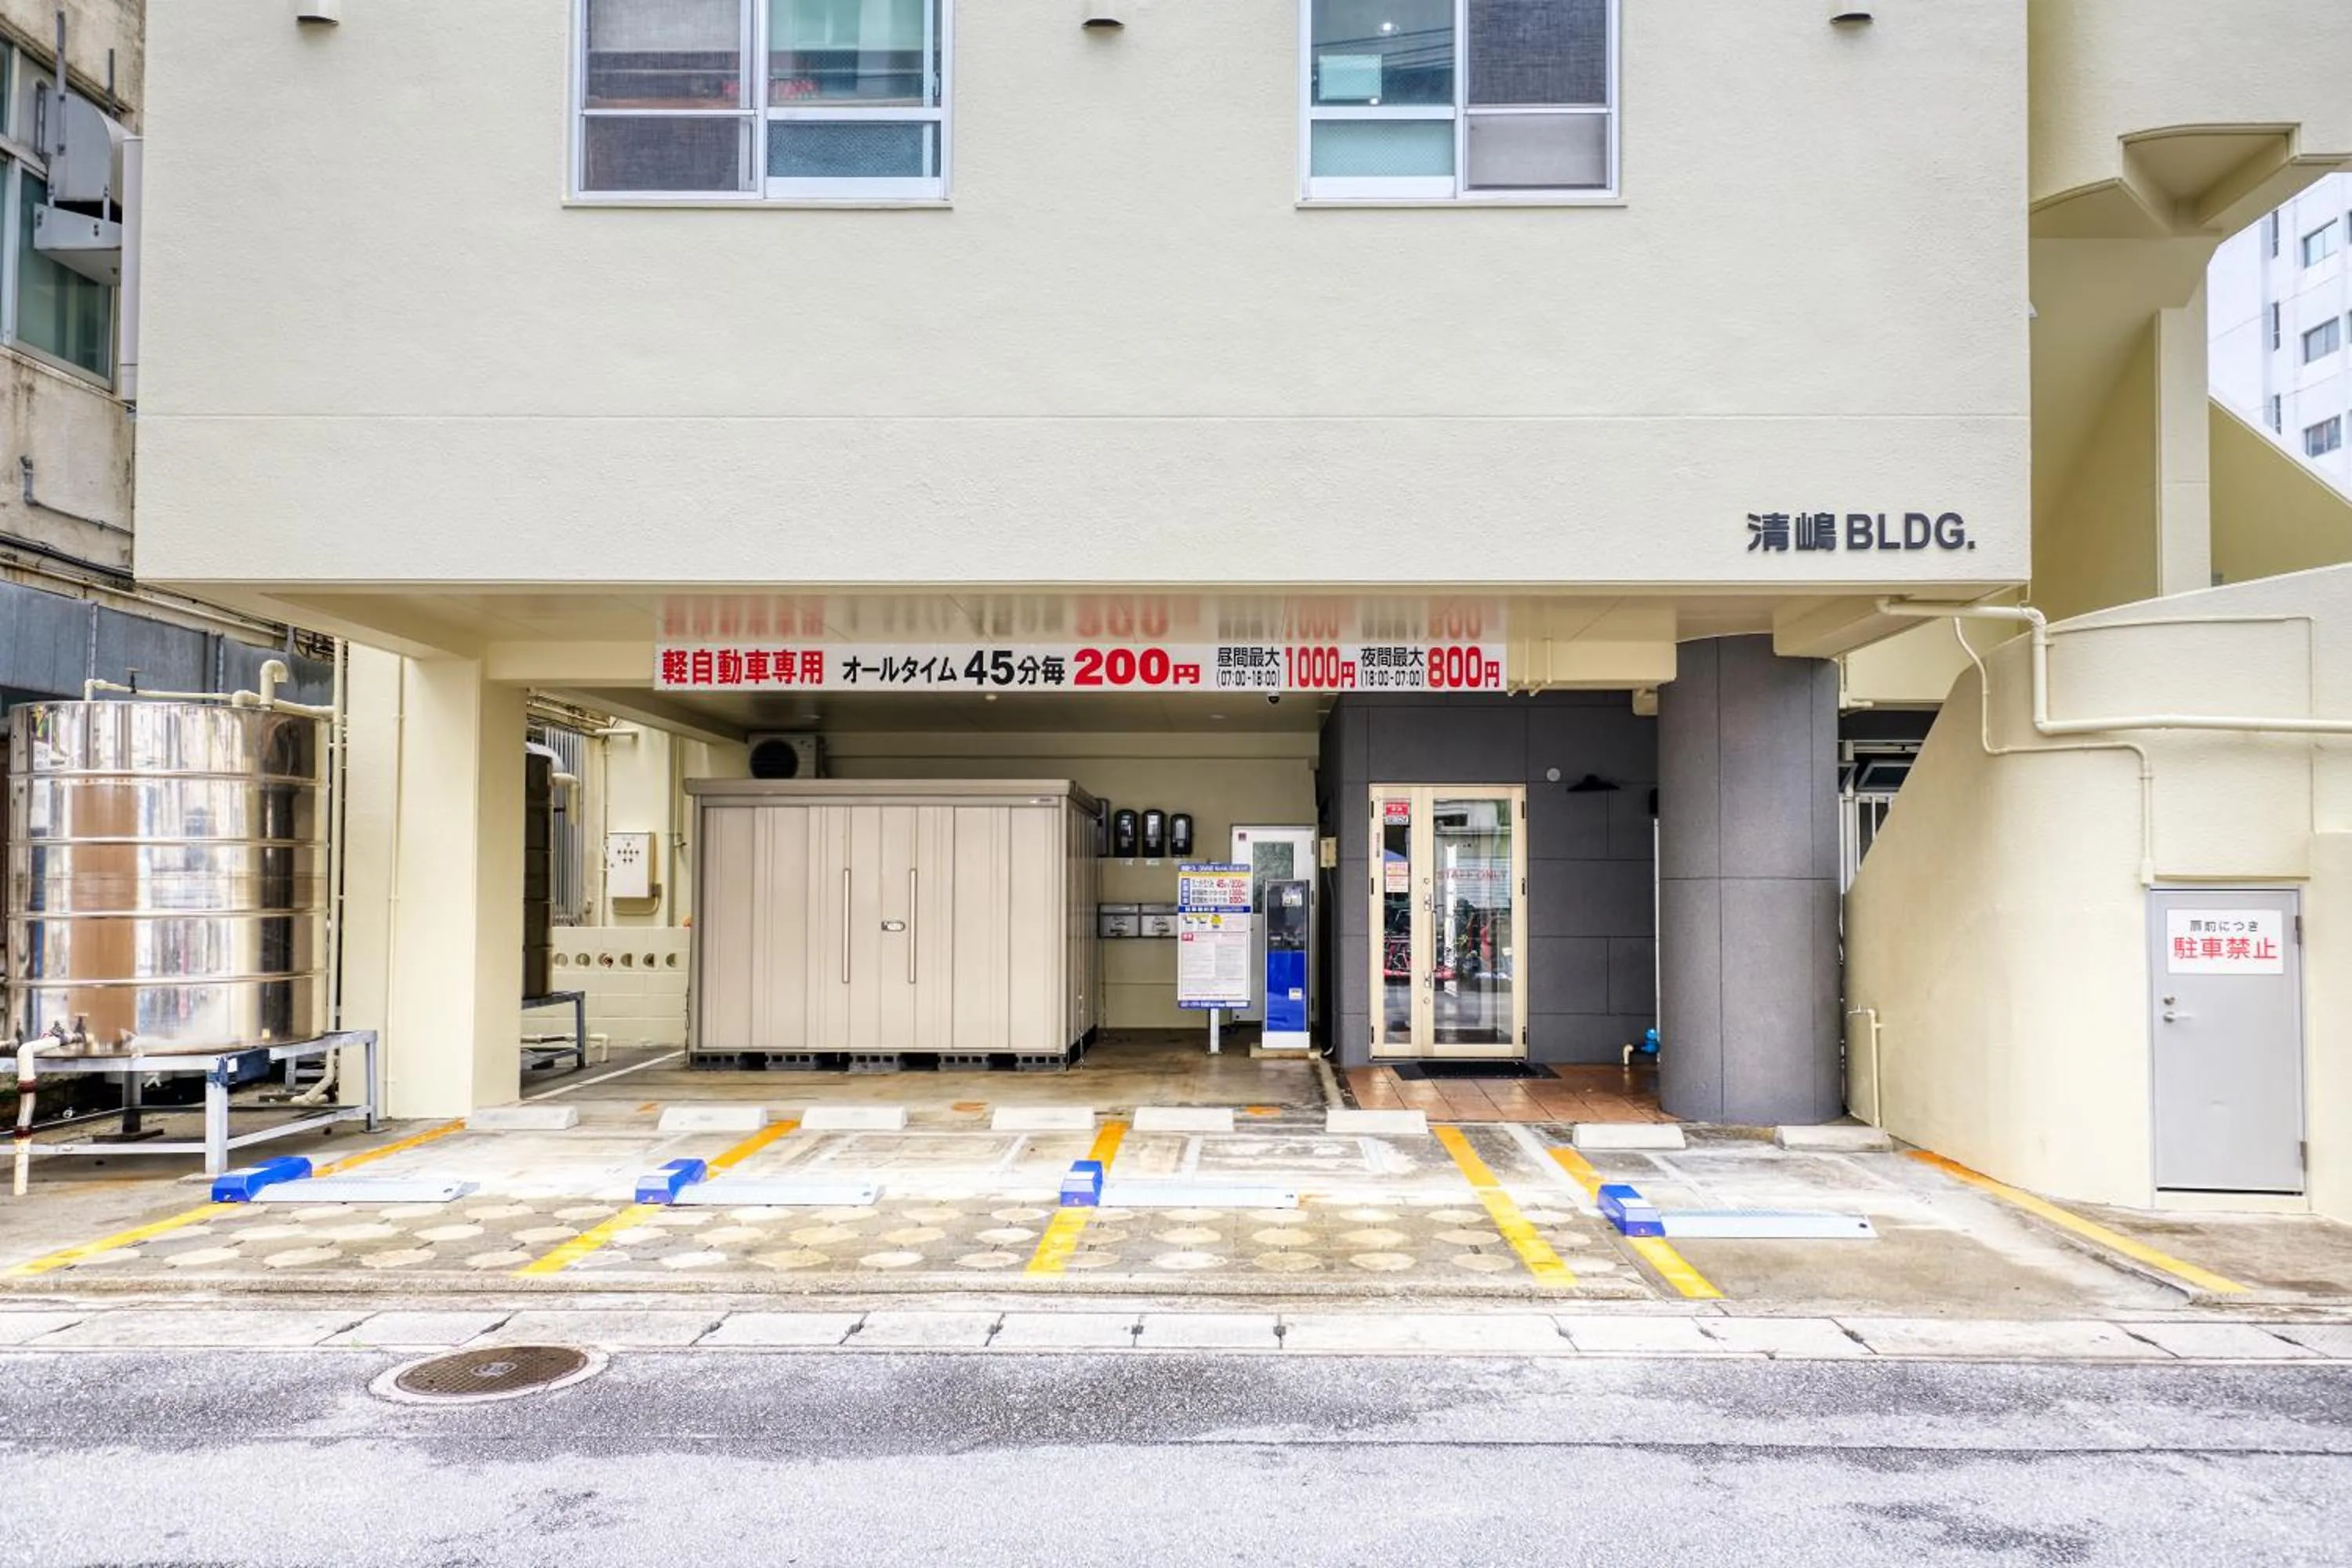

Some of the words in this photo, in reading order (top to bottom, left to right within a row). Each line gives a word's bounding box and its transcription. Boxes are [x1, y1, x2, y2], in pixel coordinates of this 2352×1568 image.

[662, 650, 824, 685] 軽自動車専用
[842, 656, 957, 684] オールタイム
[964, 651, 1065, 685] 45分毎
[1073, 648, 1200, 685] 200円
[1218, 647, 1280, 667] 昼間最大
[1285, 647, 1355, 688] 1000円
[1360, 647, 1424, 667] 夜間最大
[1428, 647, 1500, 688] 800円
[2173, 937, 2278, 960] 駐車禁止
